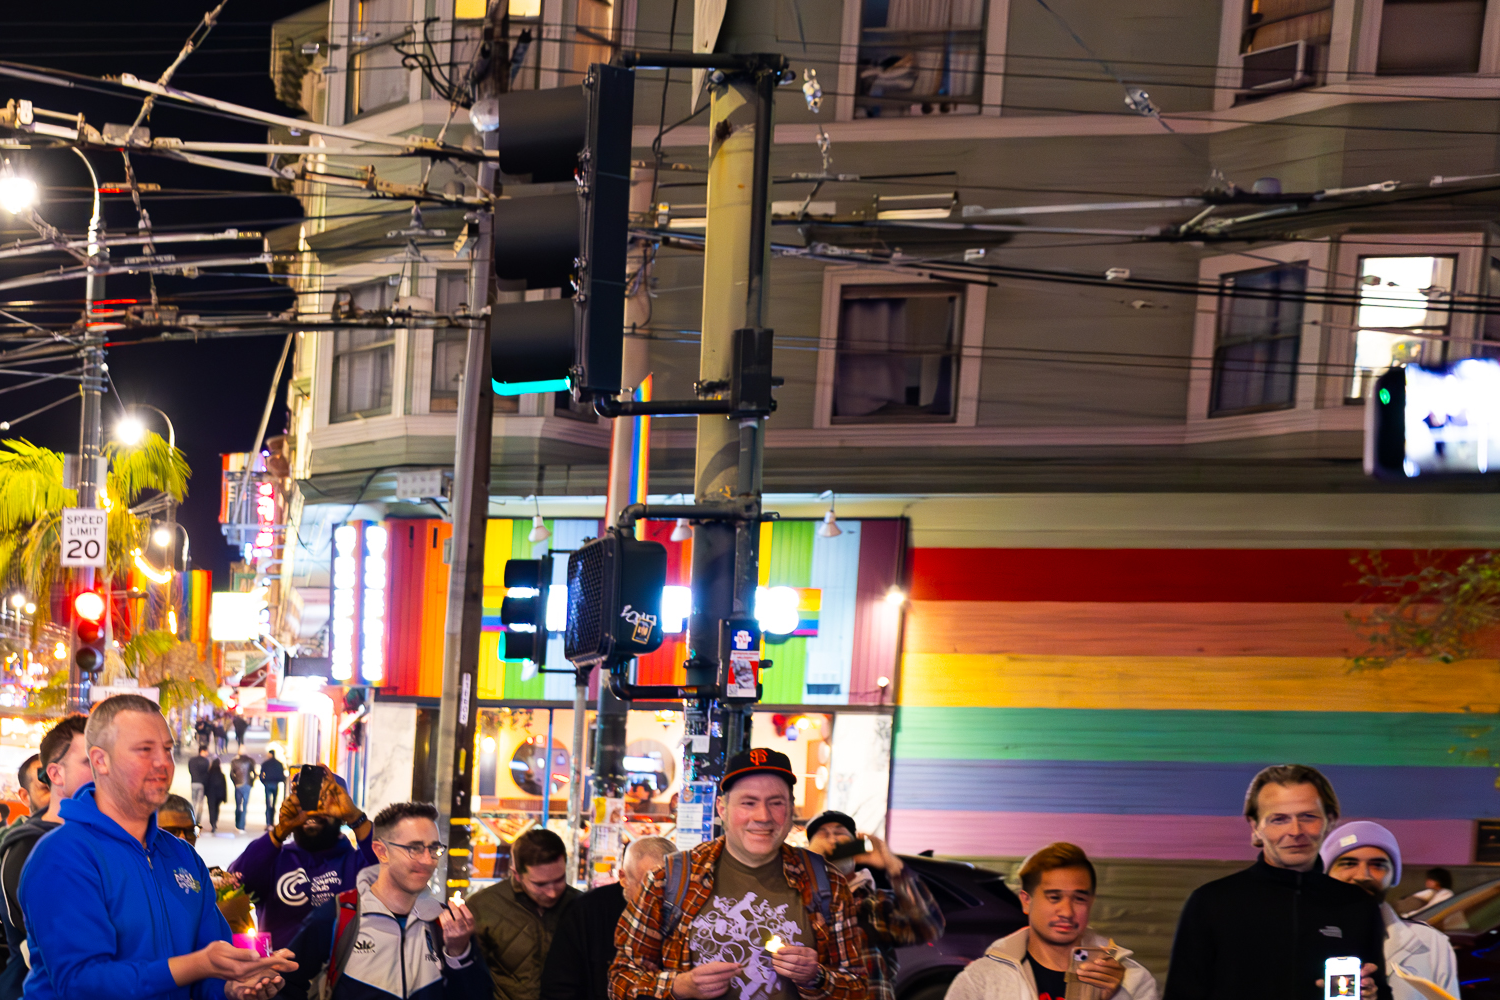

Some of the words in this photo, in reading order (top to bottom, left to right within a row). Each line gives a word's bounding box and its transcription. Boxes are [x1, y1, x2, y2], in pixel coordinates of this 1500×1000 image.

[67, 515, 103, 524] SPEED
[70, 527, 98, 536] LIMIT
[67, 539, 101, 559] 20
